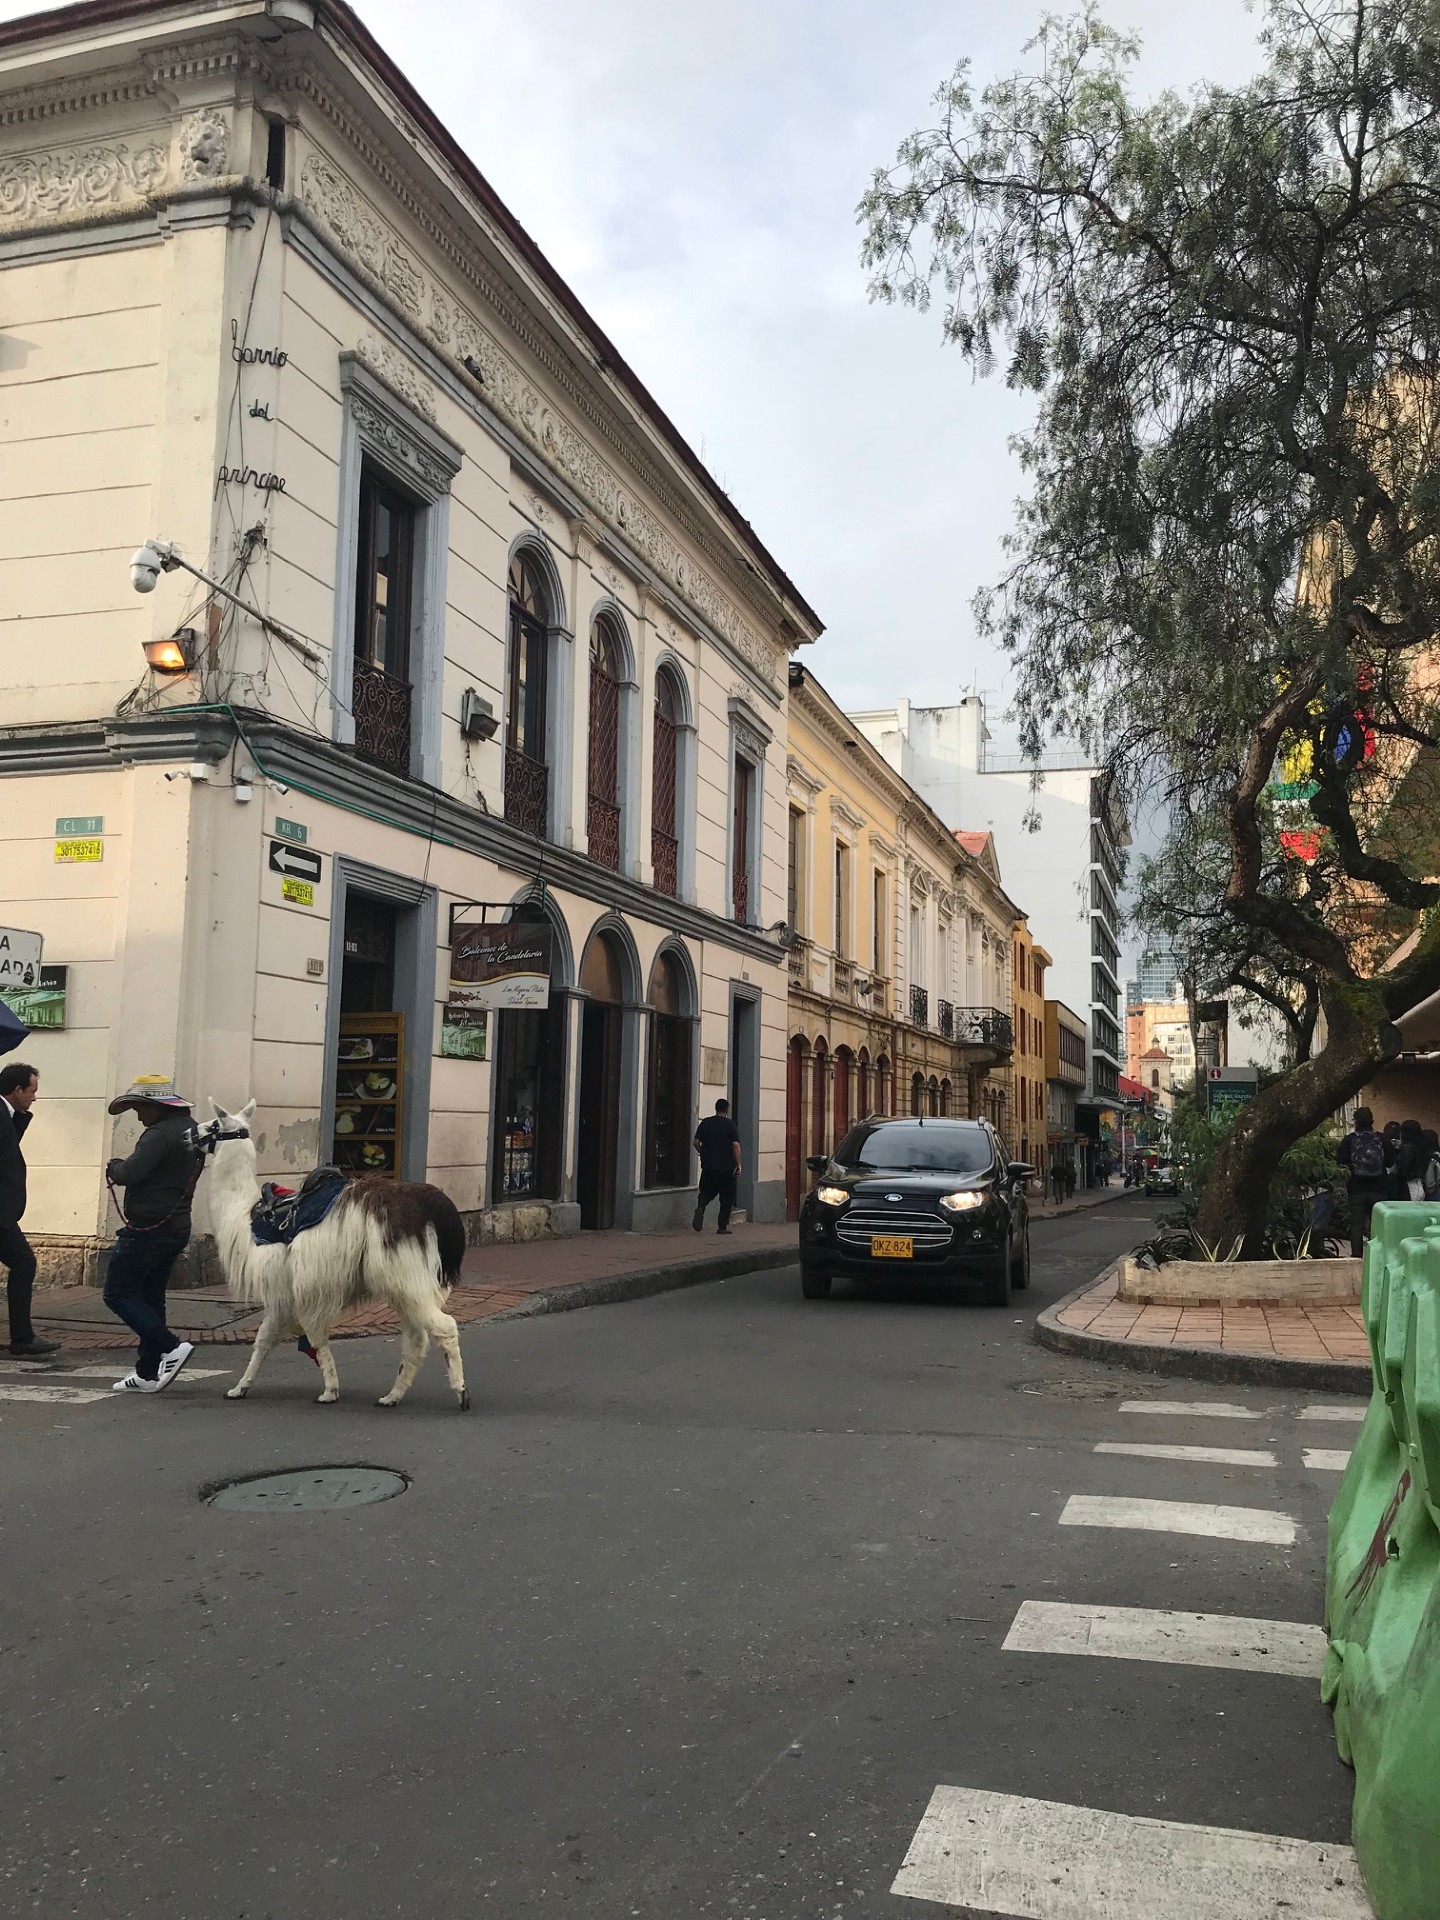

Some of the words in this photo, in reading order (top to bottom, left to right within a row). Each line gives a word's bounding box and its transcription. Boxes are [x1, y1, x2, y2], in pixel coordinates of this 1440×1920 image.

[231, 319, 288, 367] barrio
[63, 820, 77, 832] CL
[86, 819, 96, 831] 11
[281, 822, 291, 835] KR
[297, 827, 303, 839] 6
[458, 945, 497, 959] Balcones
[497, 942, 508, 952] de
[497, 949, 542, 963] Candelaria
[893, 1240, 911, 1252] 824
